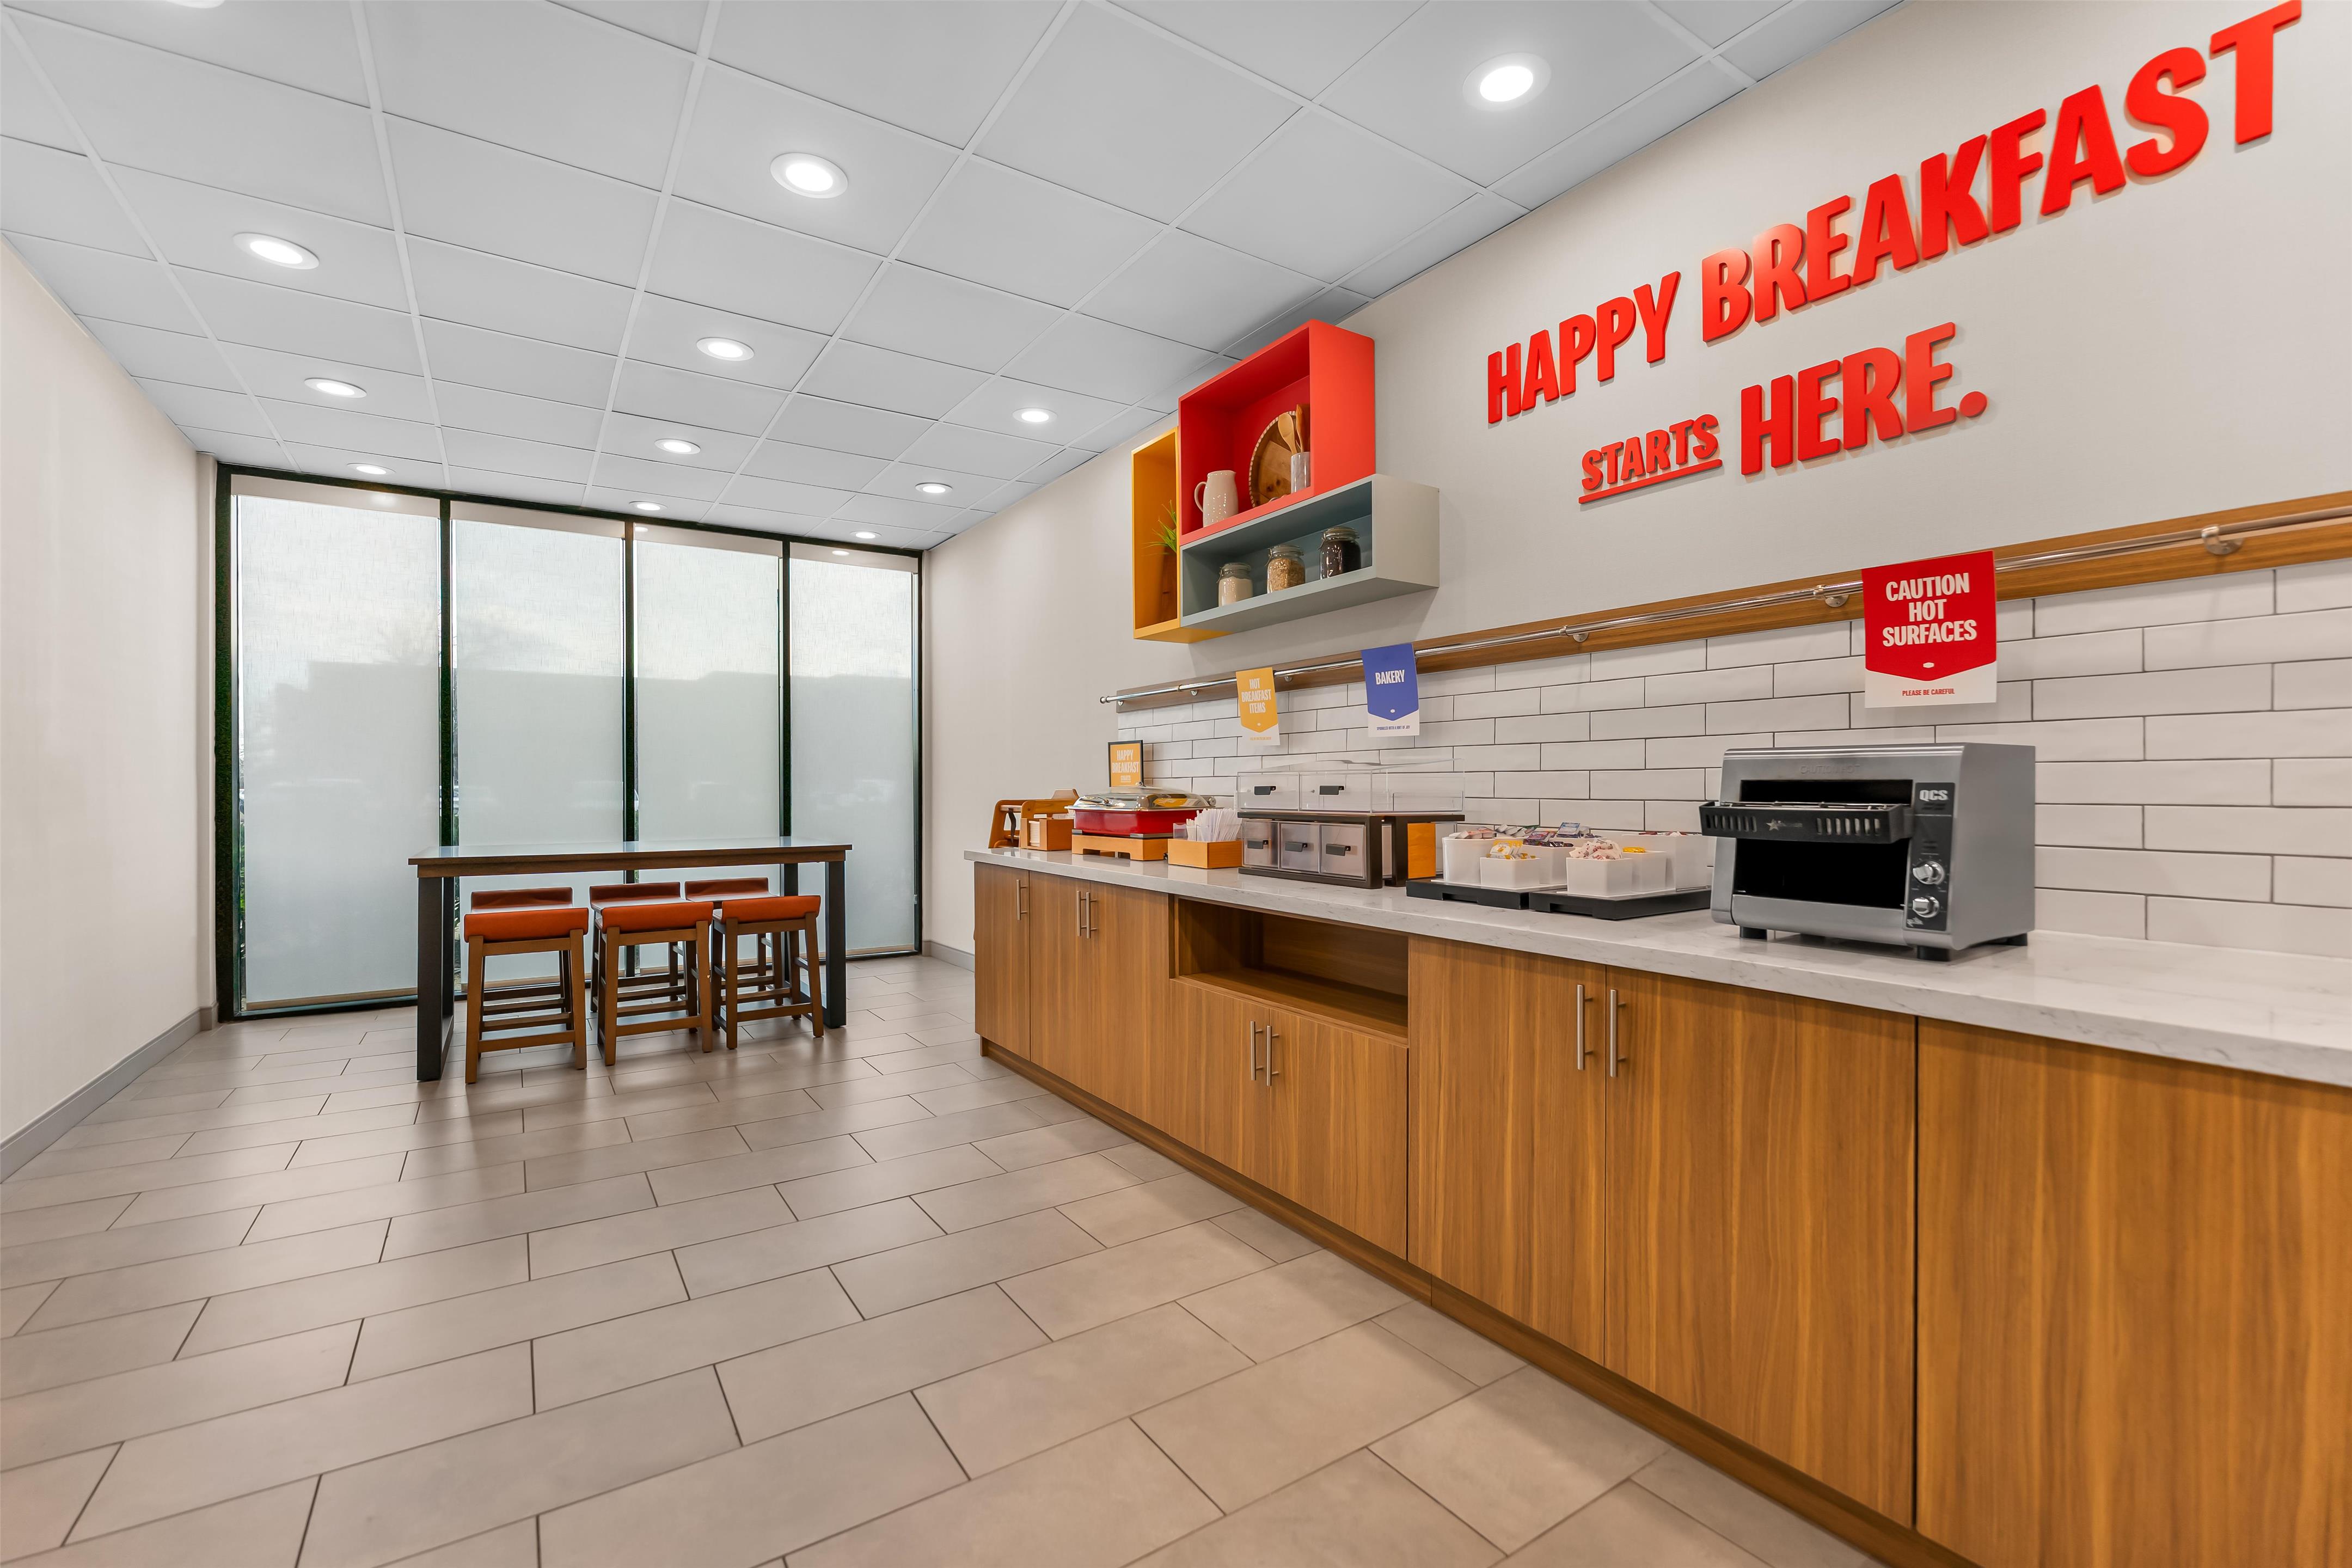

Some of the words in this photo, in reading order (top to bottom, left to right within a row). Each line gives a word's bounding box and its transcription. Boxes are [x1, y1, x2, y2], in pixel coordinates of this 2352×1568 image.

[1487, 271, 1681, 424] HAPPY
[1701, 0, 2301, 343] BREAKFAST
[1580, 413, 1719, 491] STARTS
[1741, 321, 1988, 476] HERE.
[1885, 572, 1970, 602] CAUTION
[1908, 598, 1947, 622] HOT
[1882, 619, 1977, 647] SURFACES
[1249, 678, 1260, 689] HOT
[1375, 669, 1405, 685] BAKERY
[1241, 689, 1272, 702] BREAKFAST
[1249, 702, 1266, 714] ITEMS
[1117, 749, 1134, 761] HAPPY
[1112, 761, 1140, 773] BREAKFAST
[1919, 789, 1949, 801] QCS
